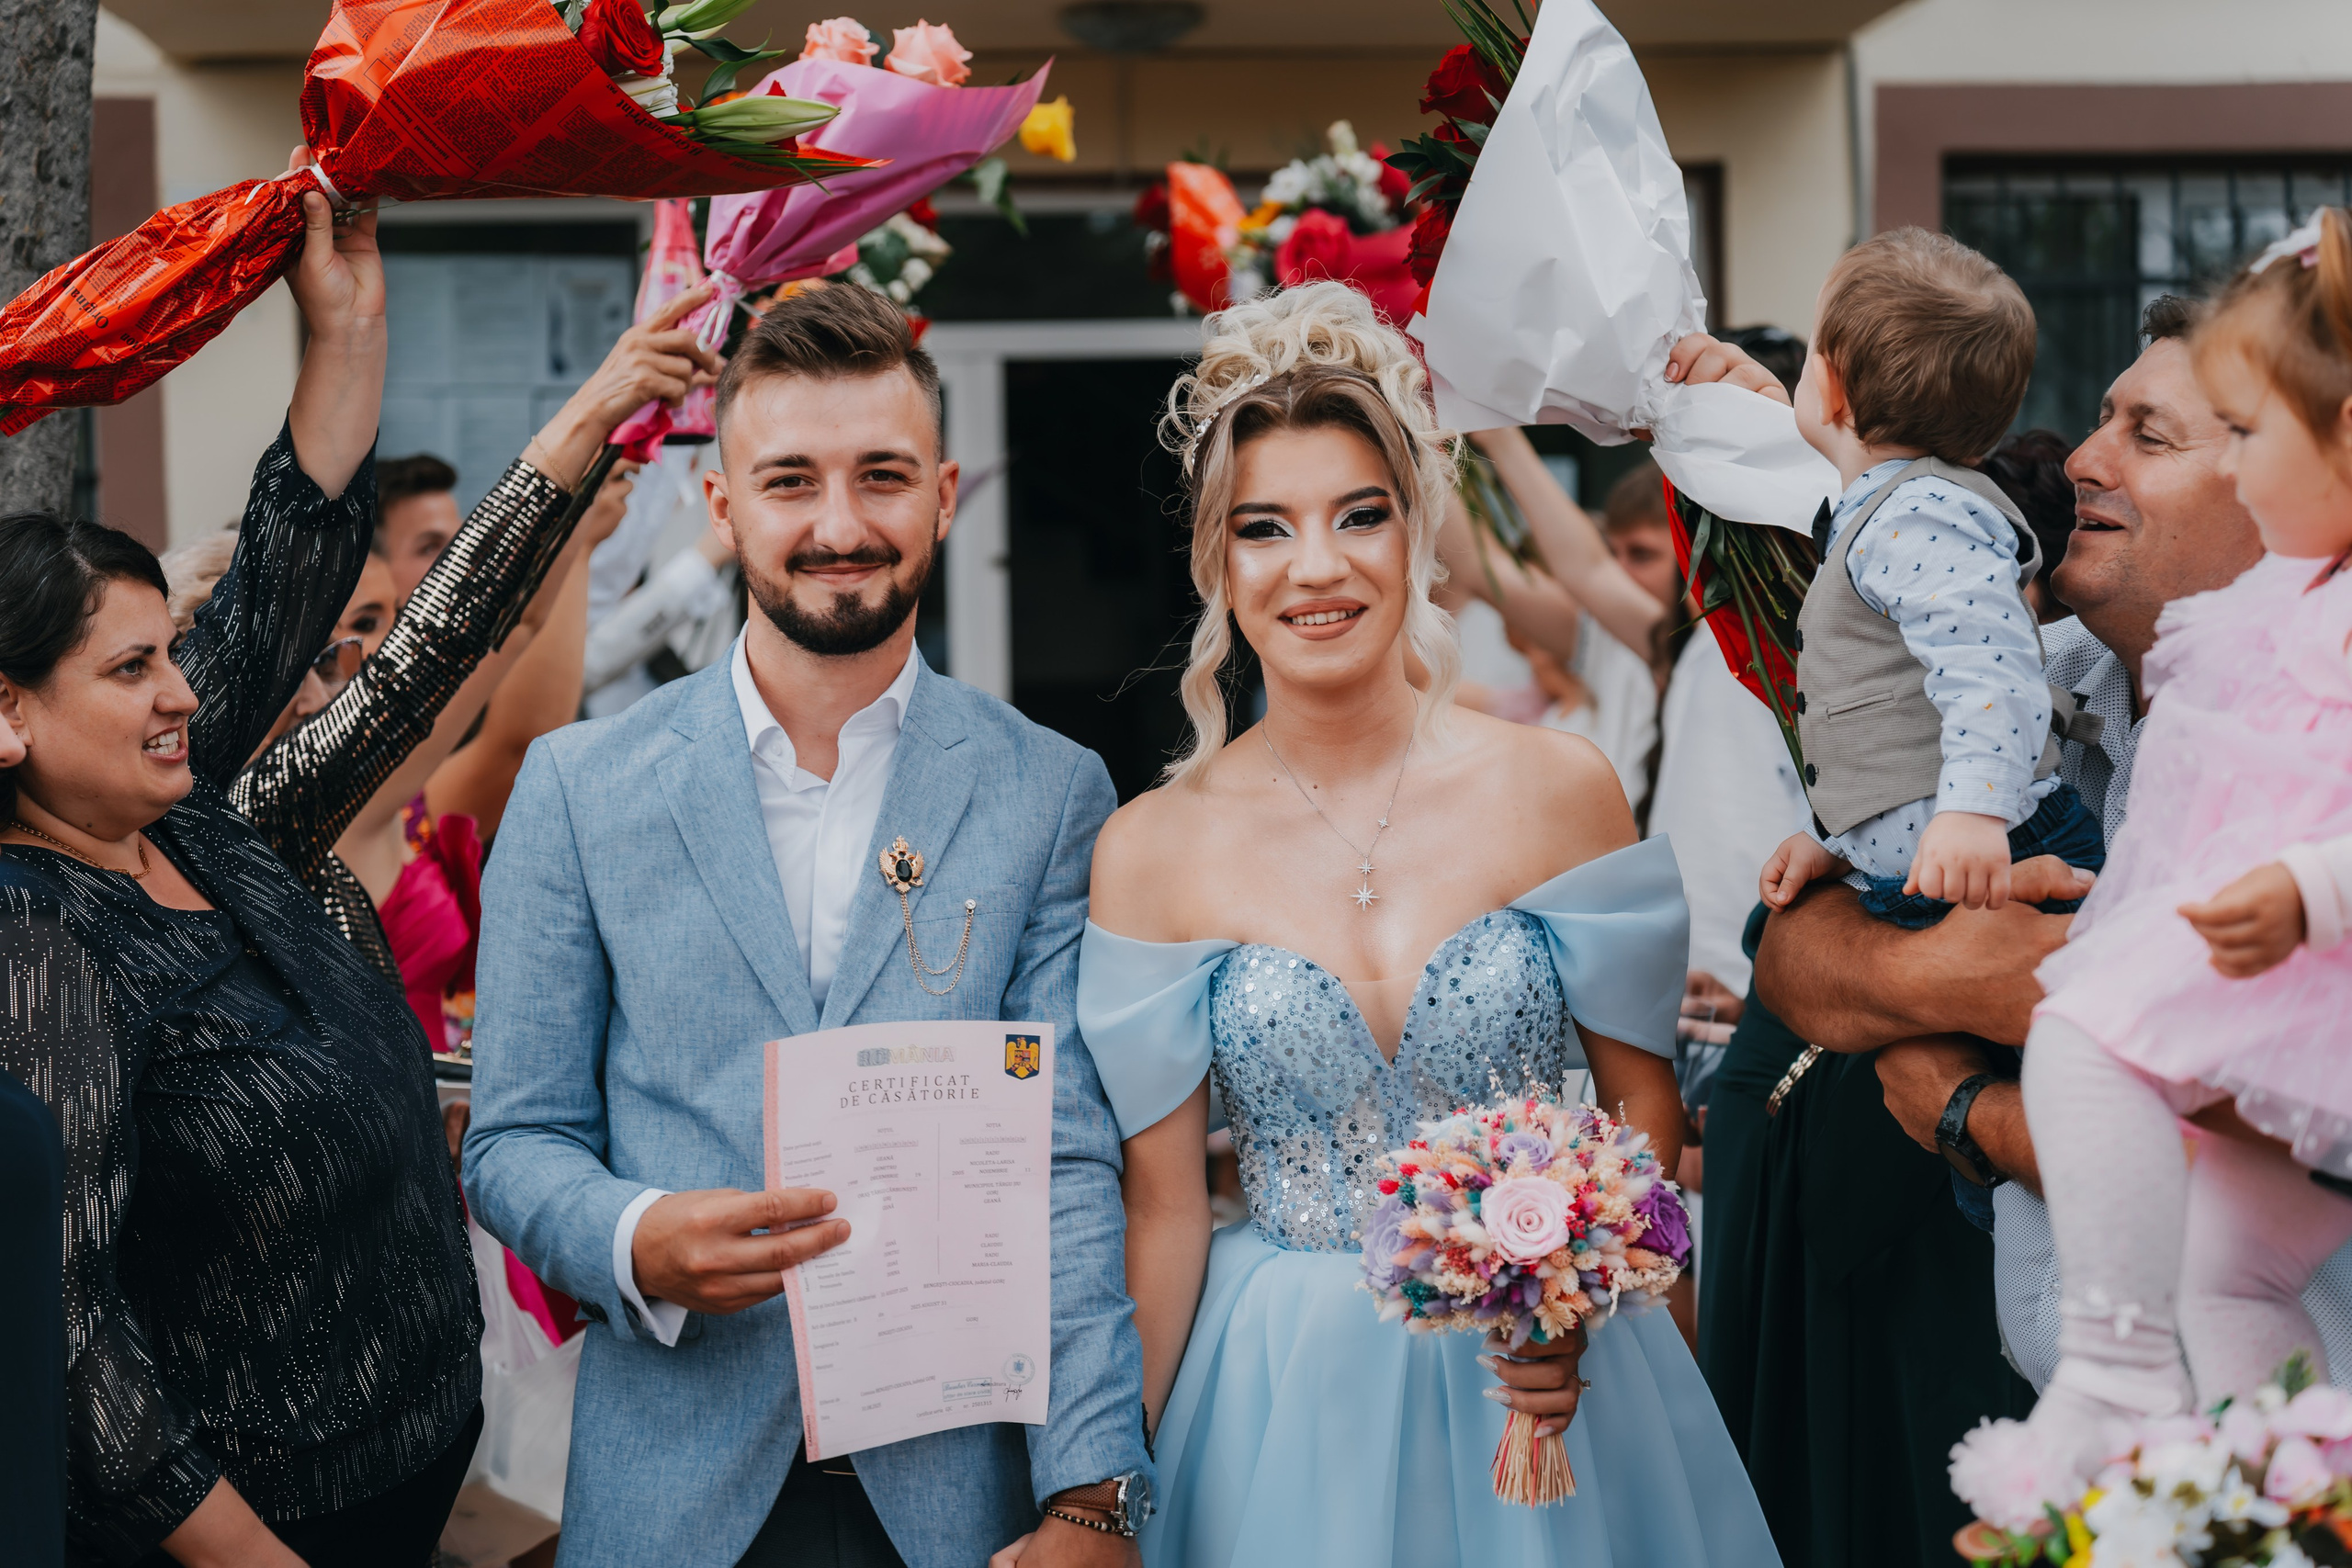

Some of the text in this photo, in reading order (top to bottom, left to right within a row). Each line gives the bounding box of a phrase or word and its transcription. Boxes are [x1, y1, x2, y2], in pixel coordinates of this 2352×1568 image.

[390, 99, 413, 124] Business
[413, 125, 449, 160] International
[65, 286, 109, 330] Original
[857, 1044, 956, 1066] ROMÂNIA
[848, 1075, 970, 1092] CERTIFICAT
[840, 1088, 979, 1108] DE CĂSĂTORIE
